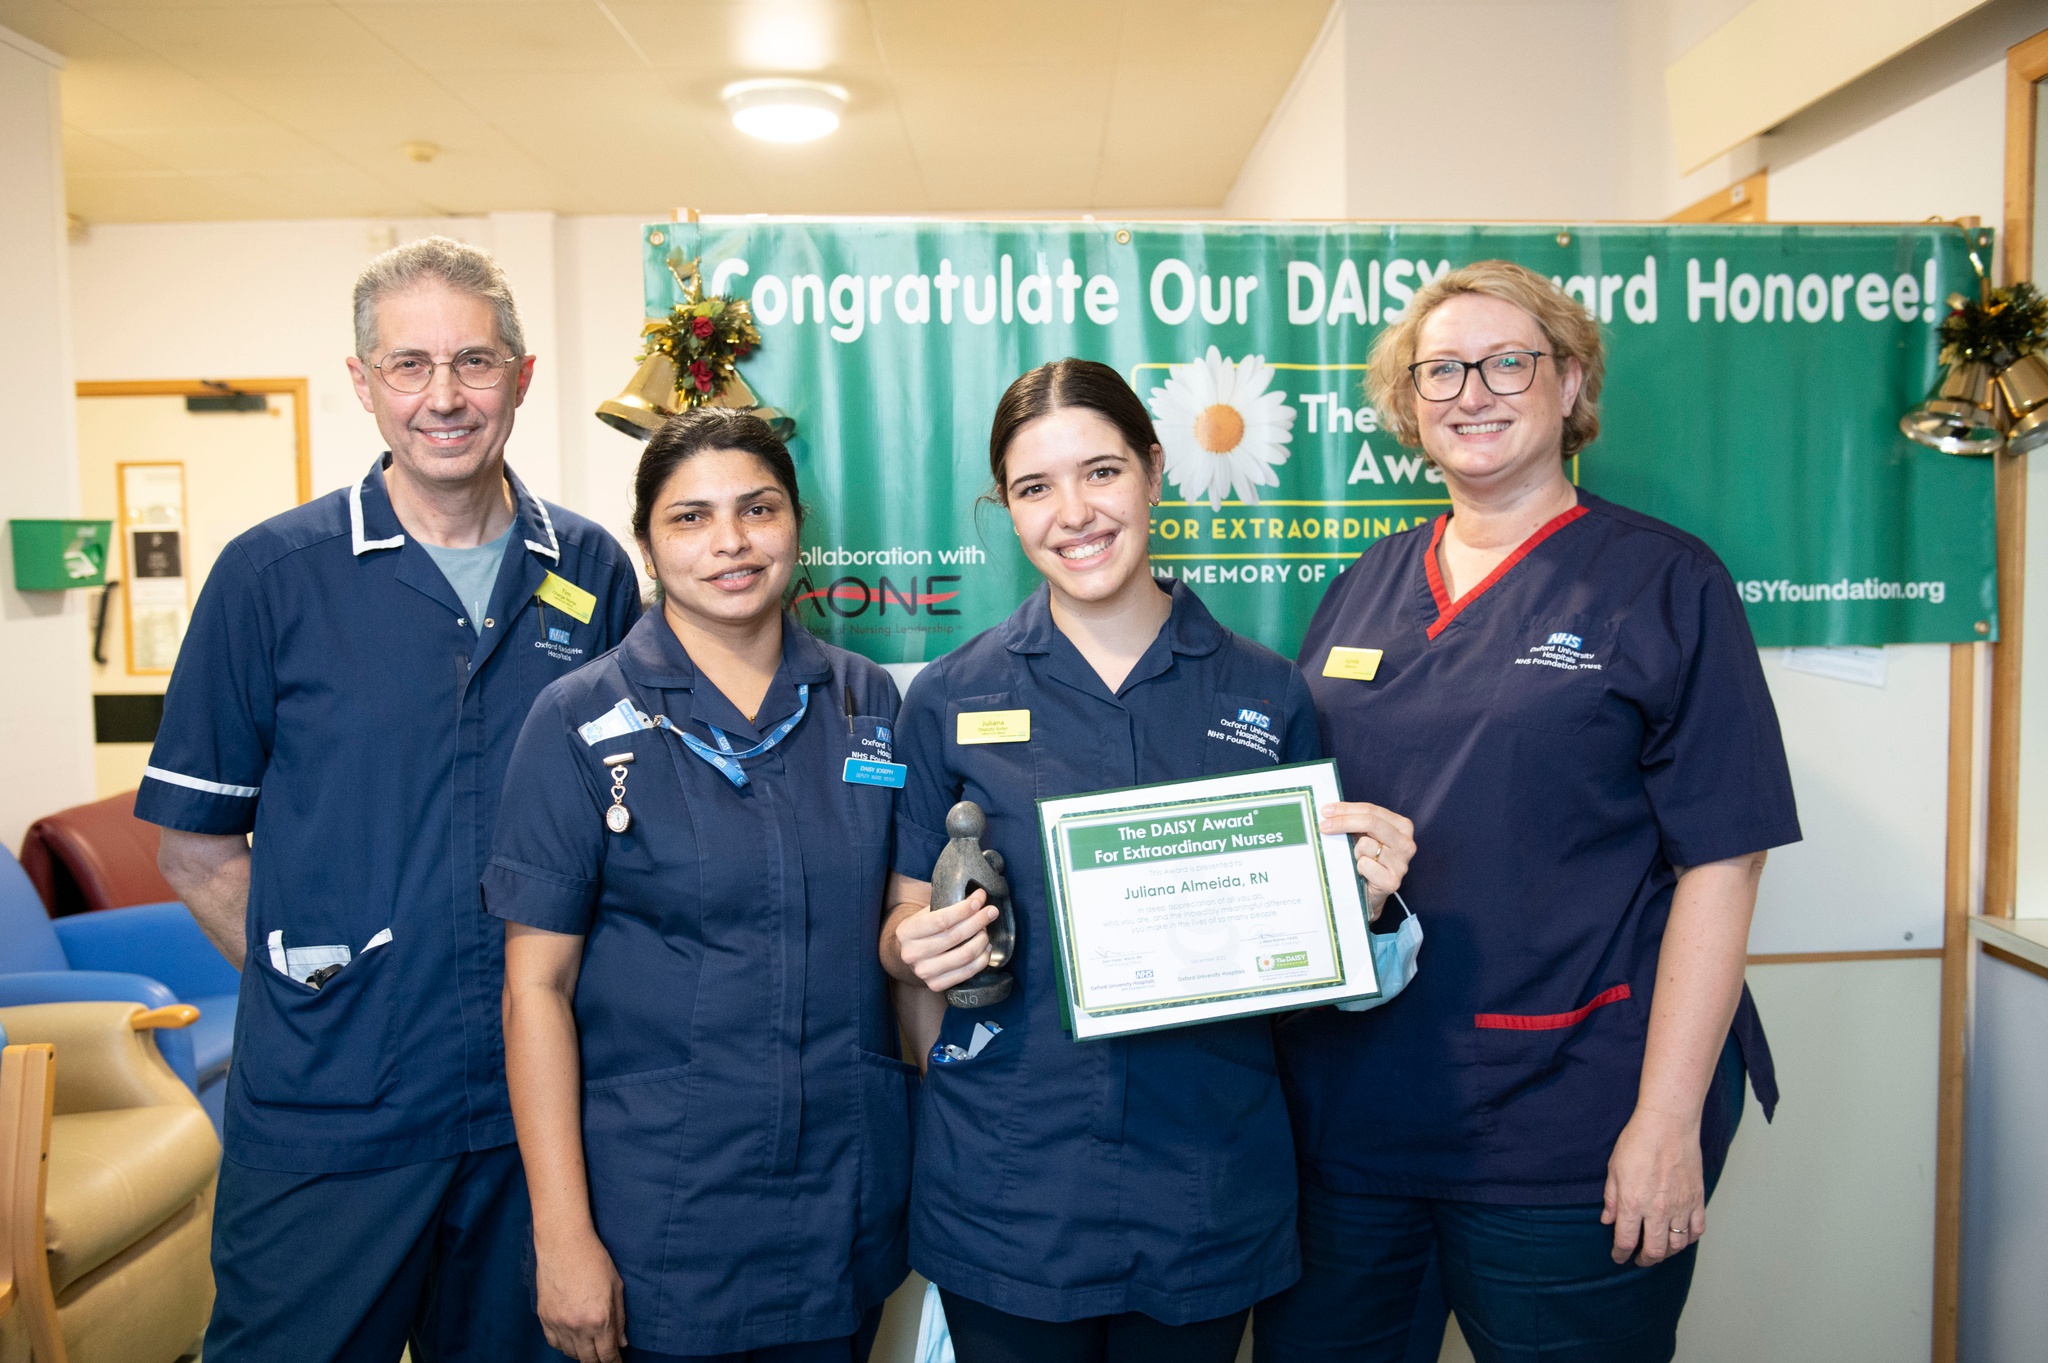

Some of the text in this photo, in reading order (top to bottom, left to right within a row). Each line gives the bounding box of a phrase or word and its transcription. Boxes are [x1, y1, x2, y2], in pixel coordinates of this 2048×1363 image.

[711, 254, 1119, 343] Congratulate
[1150, 258, 1259, 325] Our
[1551, 255, 1657, 324] ard
[1687, 256, 1937, 324] Honoree!
[1300, 392, 1377, 434] The
[1347, 440, 1447, 485] Awa
[1149, 517, 1428, 540] FOR EXTRAORDINA
[797, 545, 985, 567] ollaboration with
[1183, 564, 1291, 583] MEMORY
[1298, 564, 1326, 583] OF
[784, 575, 962, 618] AONE
[836, 624, 846, 635] of
[850, 624, 891, 637] Nursing
[535, 641, 557, 650] Oxford
[1548, 633, 1581, 648] NHS
[1530, 645, 1595, 659] Oxford University
[1542, 652, 1576, 664] Hospitals
[1532, 658, 1578, 670] Foundation
[1239, 709, 1270, 728] NHS
[1220, 718, 1281, 745] Oxford University
[1235, 729, 1267, 745] Hospitals
[861, 738, 886, 750] Oxford
[1207, 729, 1225, 740] NHS
[1226, 735, 1268, 754] Foundation
[1118, 826, 1147, 841] The
[1151, 818, 1197, 837] DAISY
[1095, 831, 1284, 864] For Extraordinary Nurses
[1164, 866, 1188, 875] Award
[1196, 862, 1233, 873] presented
[1124, 871, 1269, 900] Juliana Almeida, RN
[1103, 919, 1120, 927] who
[1121, 917, 1135, 927] you
[1153, 912, 1168, 921] and
[1170, 910, 1182, 920] the
[1183, 906, 1219, 919] incredibly
[1221, 900, 1263, 914] meaningful
[1264, 897, 1301, 909] difference
[1146, 904, 1166, 915] deep
[1168, 898, 1216, 913] appreciation
[1227, 895, 1235, 904] all
[1237, 895, 1250, 905] you
[1131, 926, 1145, 935] you
[1146, 922, 1168, 931] make
[1177, 919, 1190, 928] the
[1191, 917, 1207, 926] lives
[1208, 916, 1217, 924] of
[1218, 915, 1226, 923] so
[1228, 913, 1249, 923] many
[1250, 910, 1277, 920] people
[1285, 954, 1306, 963] DAISY
[1136, 970, 1154, 979] NHS
[1197, 972, 1221, 980] University
[1222, 969, 1246, 977] Hospitals
[1108, 981, 1132, 989] University
